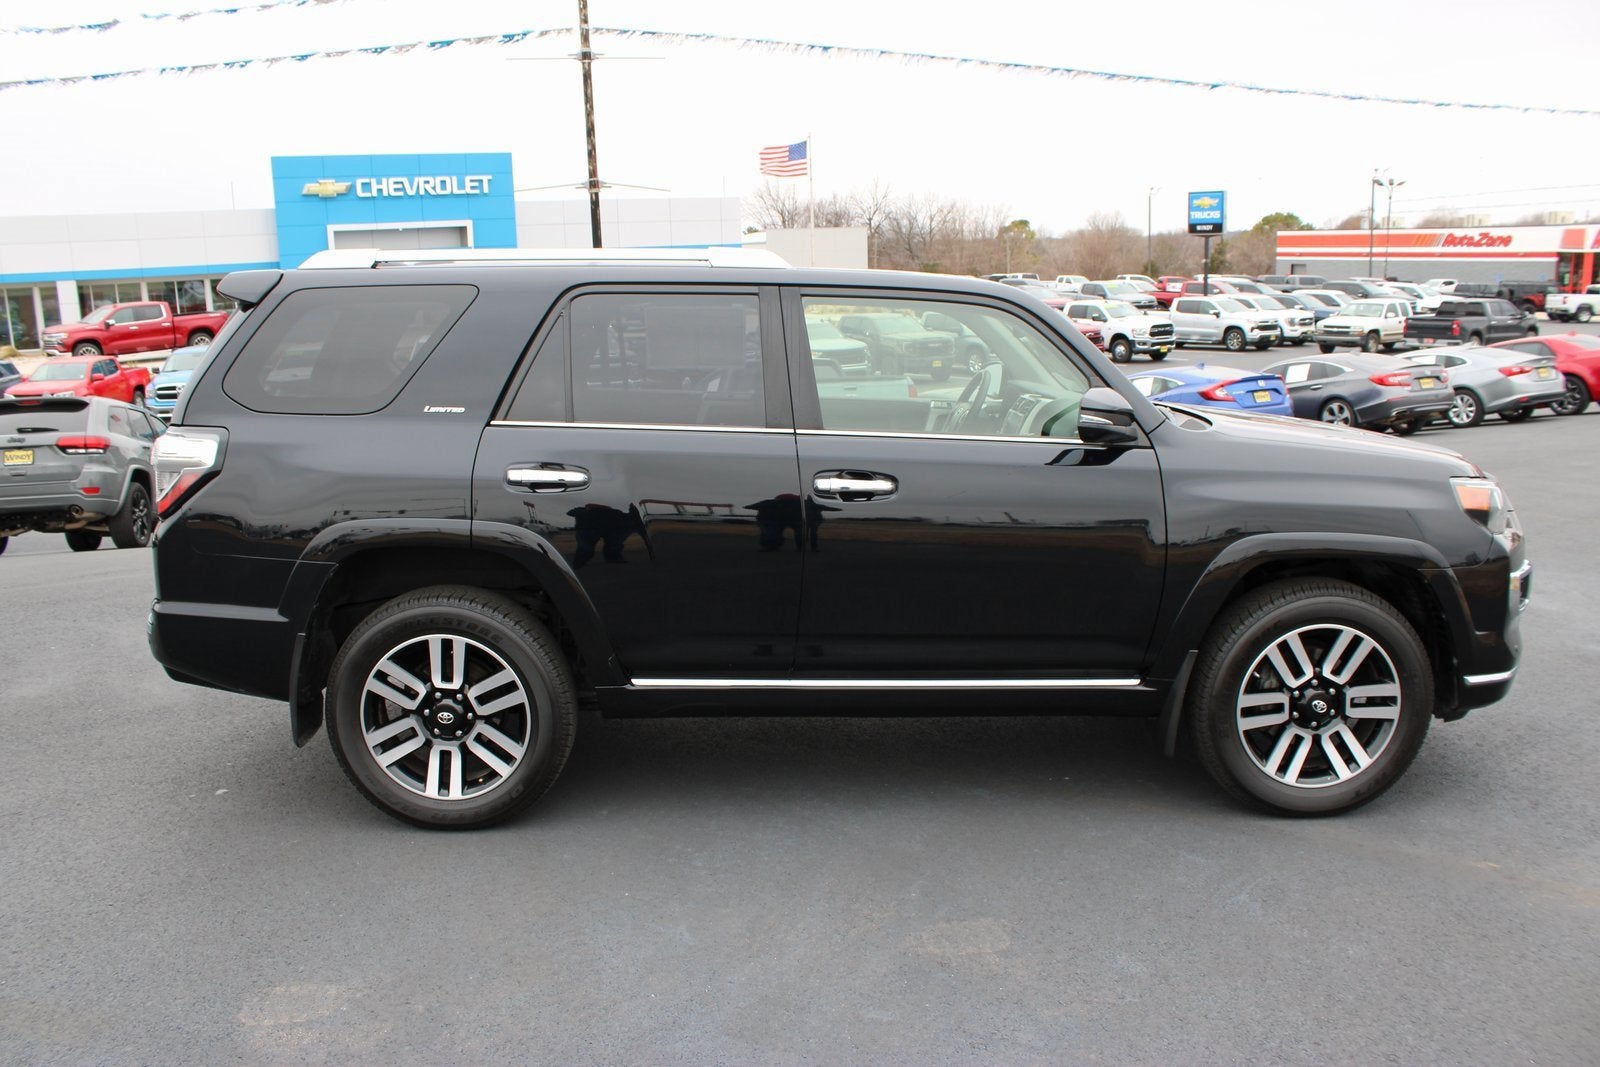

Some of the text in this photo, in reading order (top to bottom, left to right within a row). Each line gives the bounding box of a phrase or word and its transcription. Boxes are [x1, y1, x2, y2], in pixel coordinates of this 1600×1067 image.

[355, 175, 493, 198] CHEVROLET
[1190, 210, 1221, 219] TRUCKS
[1442, 232, 1513, 247] AutoZone
